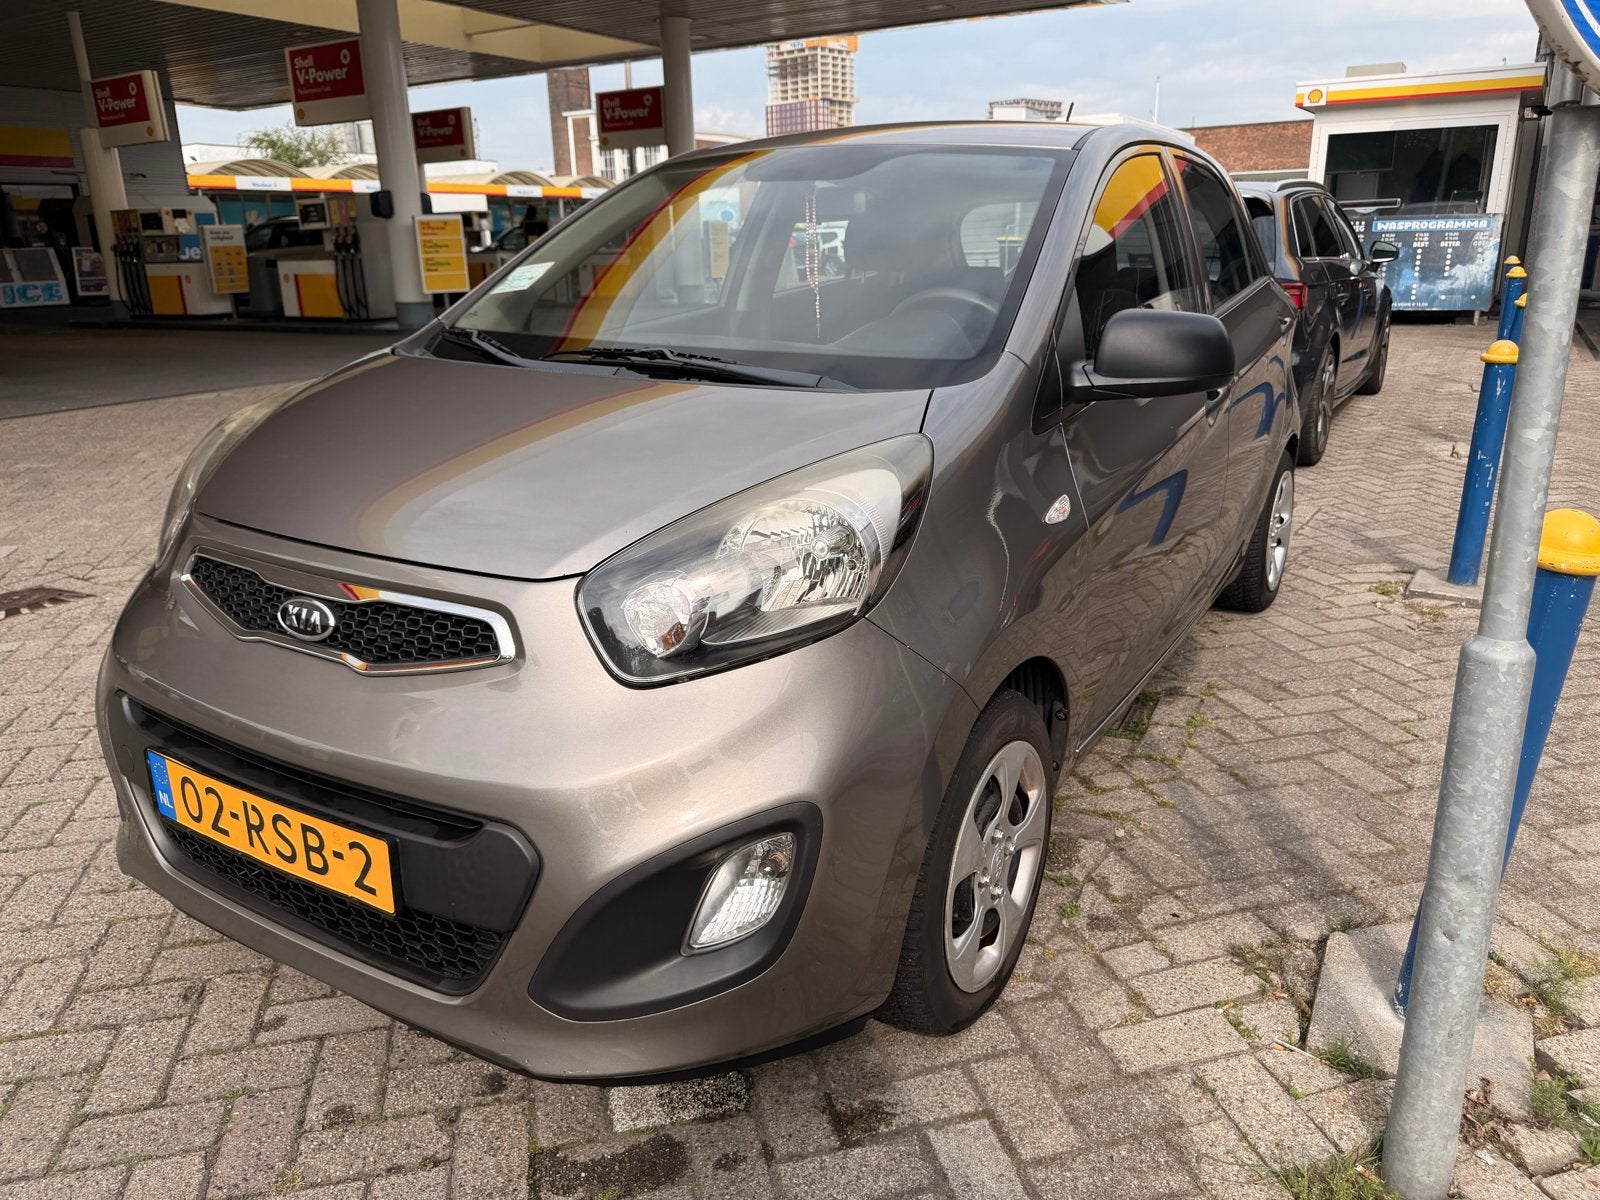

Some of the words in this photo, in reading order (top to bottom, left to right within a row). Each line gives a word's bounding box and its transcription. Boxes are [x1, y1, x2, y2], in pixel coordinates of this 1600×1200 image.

[294, 54, 314, 69] Shell
[296, 67, 348, 85] V-Power
[95, 86, 111, 99] Shell
[97, 97, 136, 112] V-Power
[603, 107, 650, 120] V-Power
[1377, 219, 1488, 231] WASPROGRAMMA
[3, 283, 63, 305] ICE
[285, 604, 322, 633] KIA
[158, 790, 173, 809] NL
[180, 776, 377, 896] 02-RSB-2
